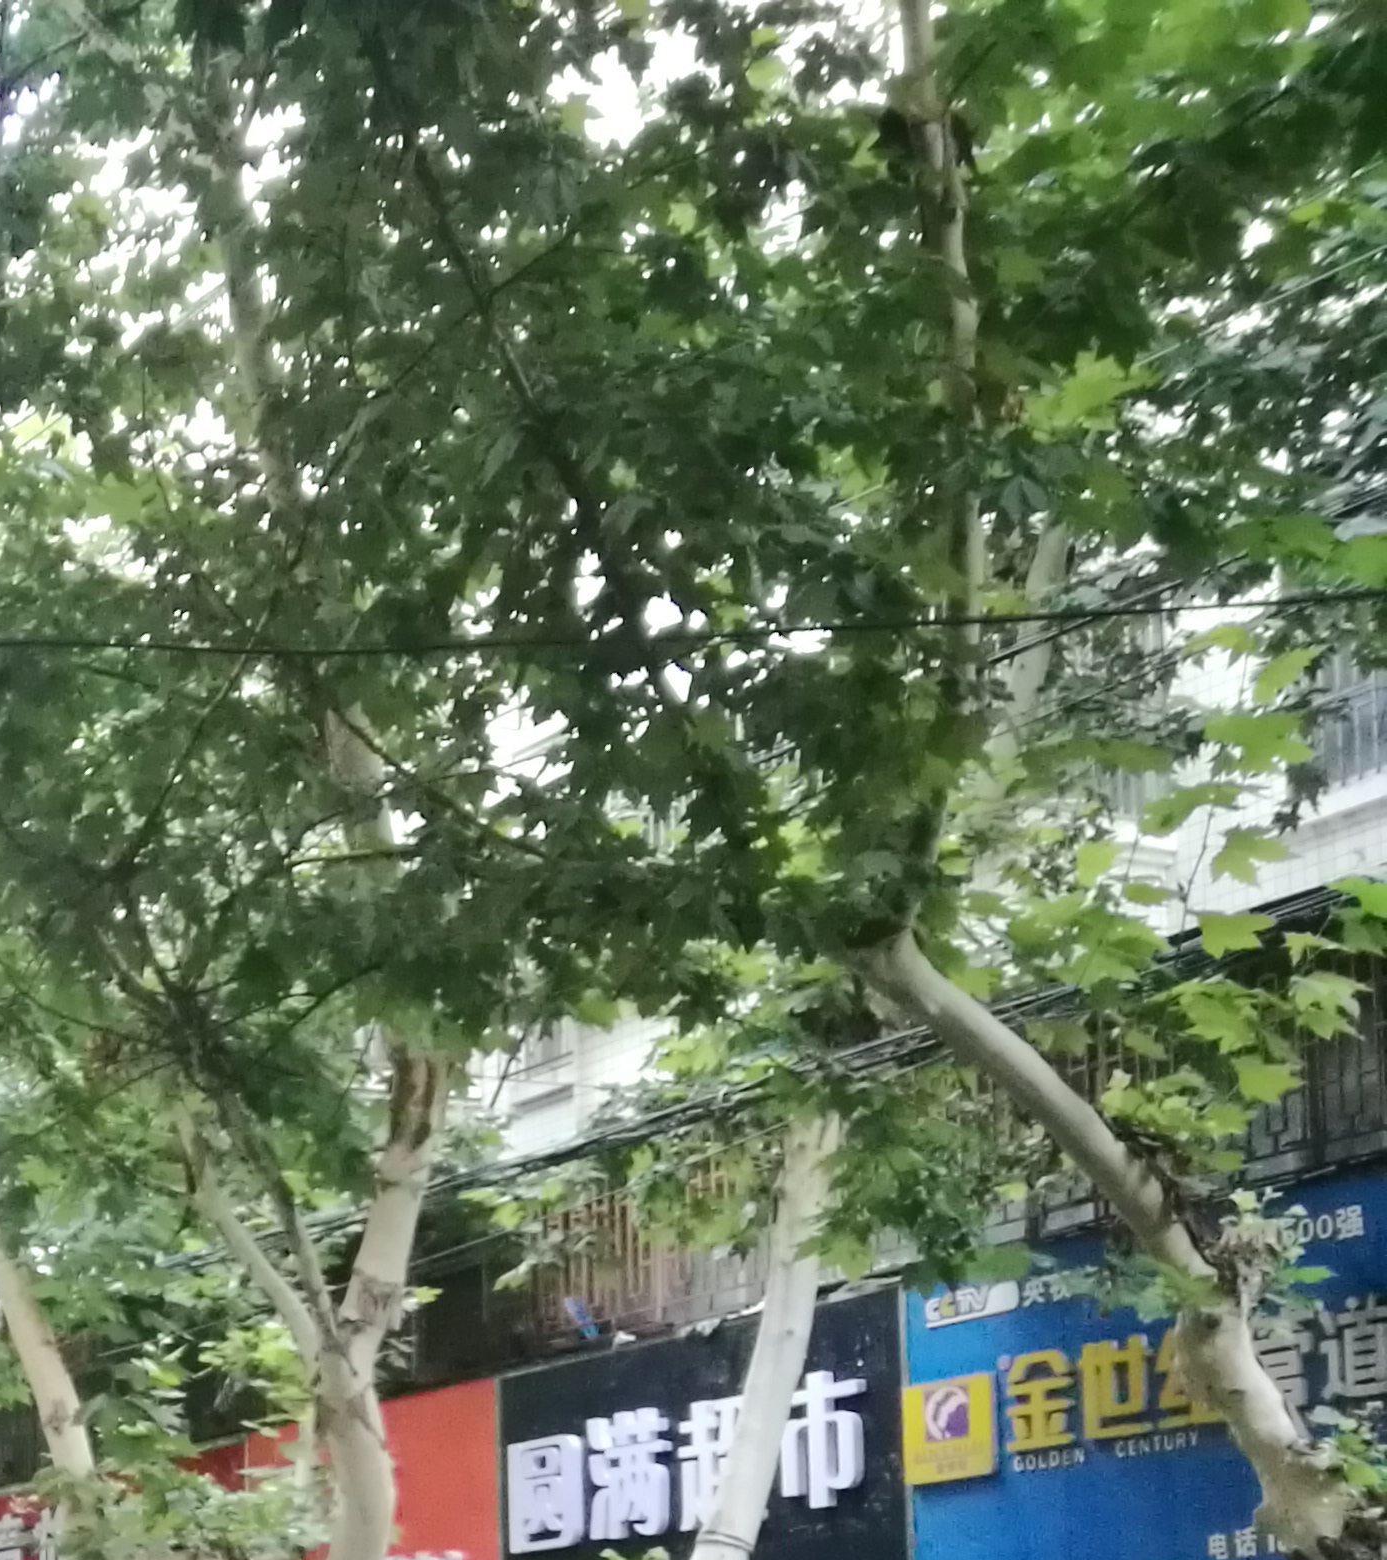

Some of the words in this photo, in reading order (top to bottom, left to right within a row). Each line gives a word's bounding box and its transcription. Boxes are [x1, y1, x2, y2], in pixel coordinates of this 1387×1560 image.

[507, 1370, 867, 1554] 圆满超市
[1013, 1447, 1086, 1473] GOLDEN
[1114, 1430, 1200, 1459] CENTURY
[1207, 1526, 1257, 1560] 电话
